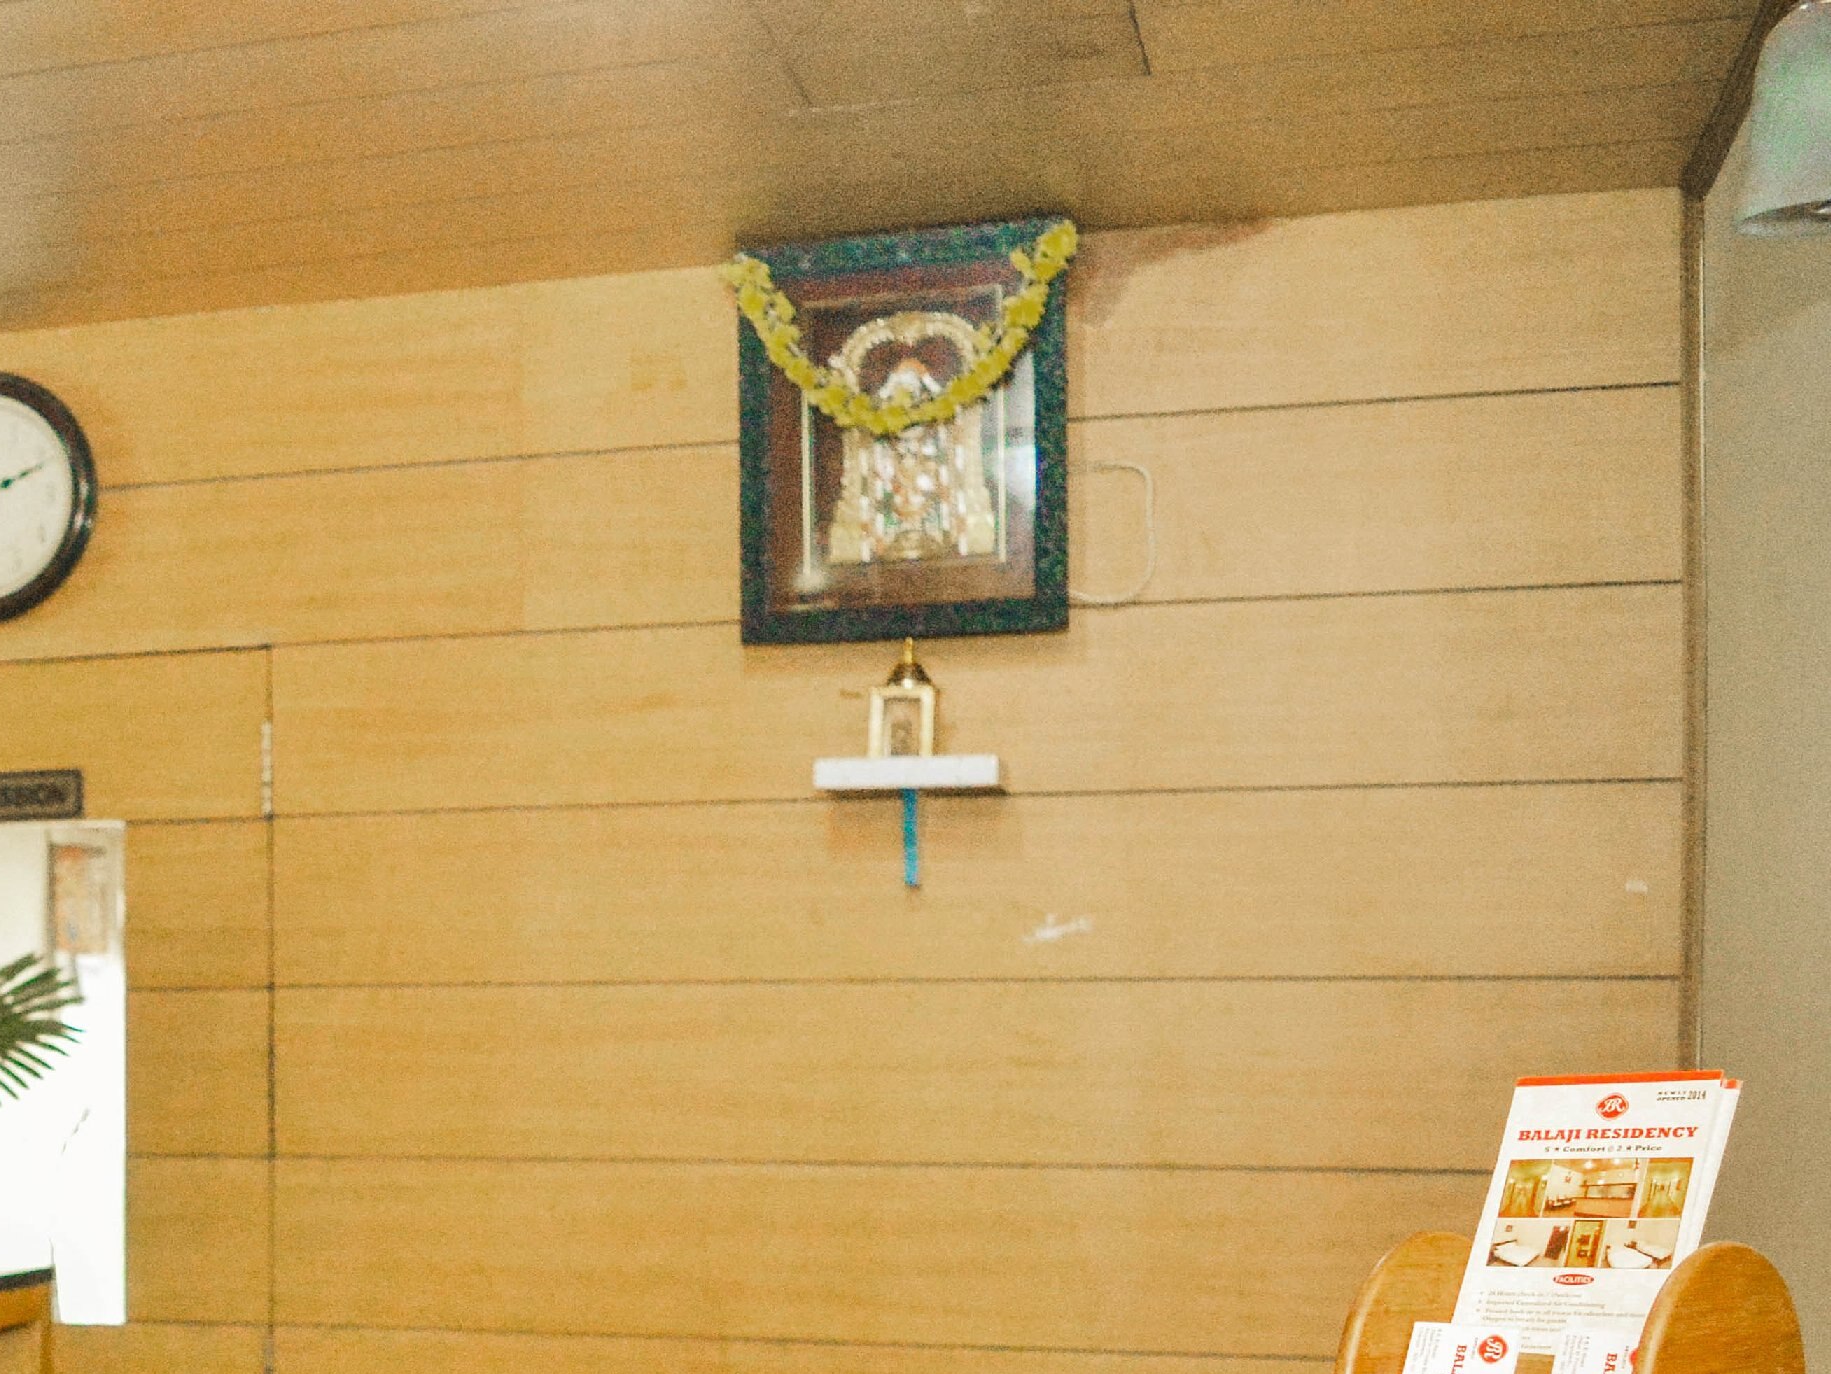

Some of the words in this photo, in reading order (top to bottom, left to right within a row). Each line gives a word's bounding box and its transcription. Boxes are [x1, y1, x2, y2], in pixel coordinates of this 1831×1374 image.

[1518, 1128, 1582, 1143] BALAJI
[1586, 1126, 1699, 1140] RESIDENCY
[1562, 1145, 1606, 1153] Comfort
[1635, 1144, 1663, 1152] Price
